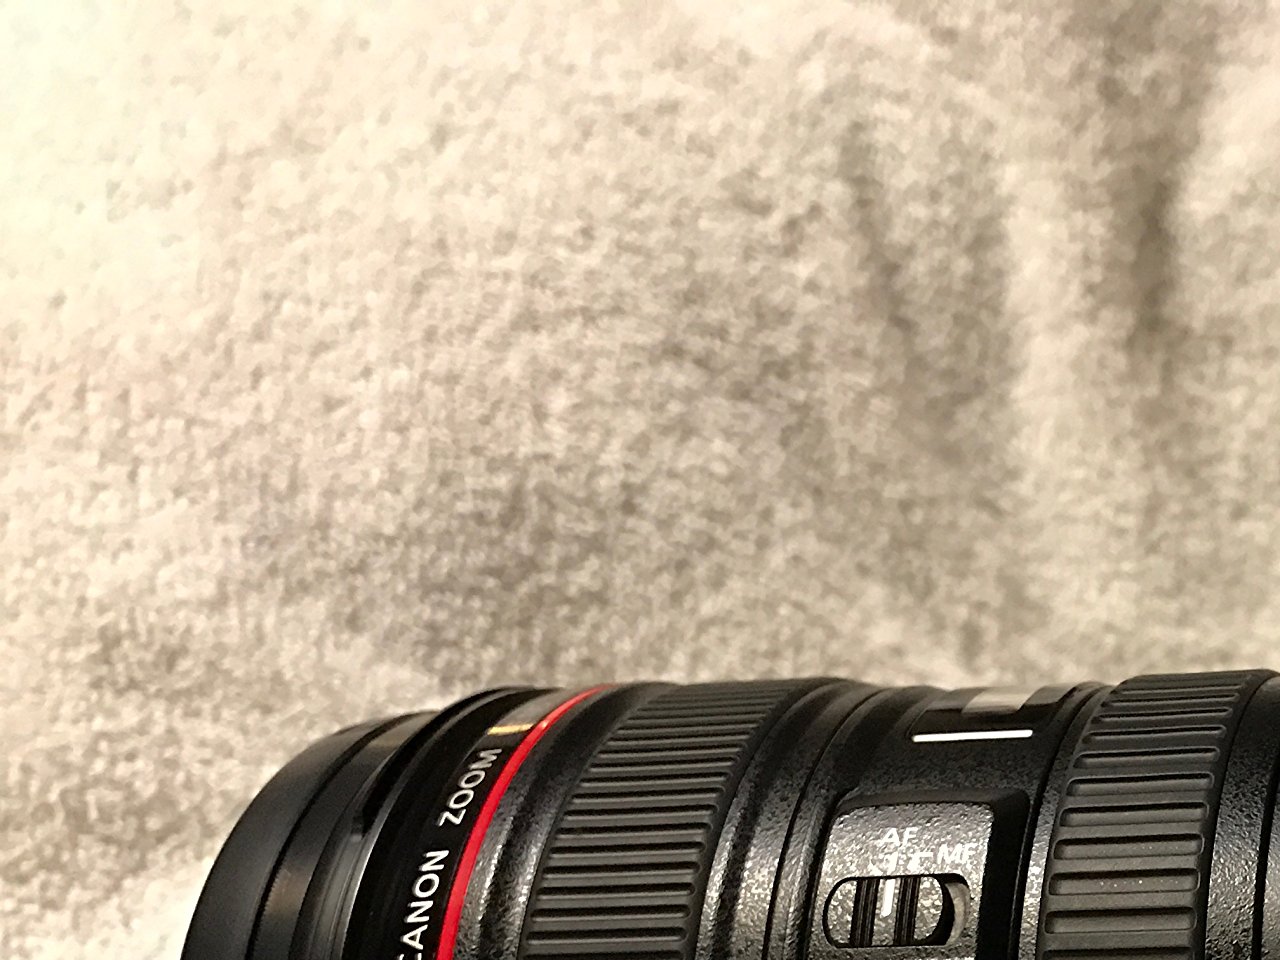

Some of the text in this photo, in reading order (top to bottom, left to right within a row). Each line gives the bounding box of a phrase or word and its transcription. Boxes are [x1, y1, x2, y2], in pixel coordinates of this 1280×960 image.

[435, 748, 502, 828] ZOOM
[880, 826, 919, 848] AF
[937, 843, 978, 865] MF
